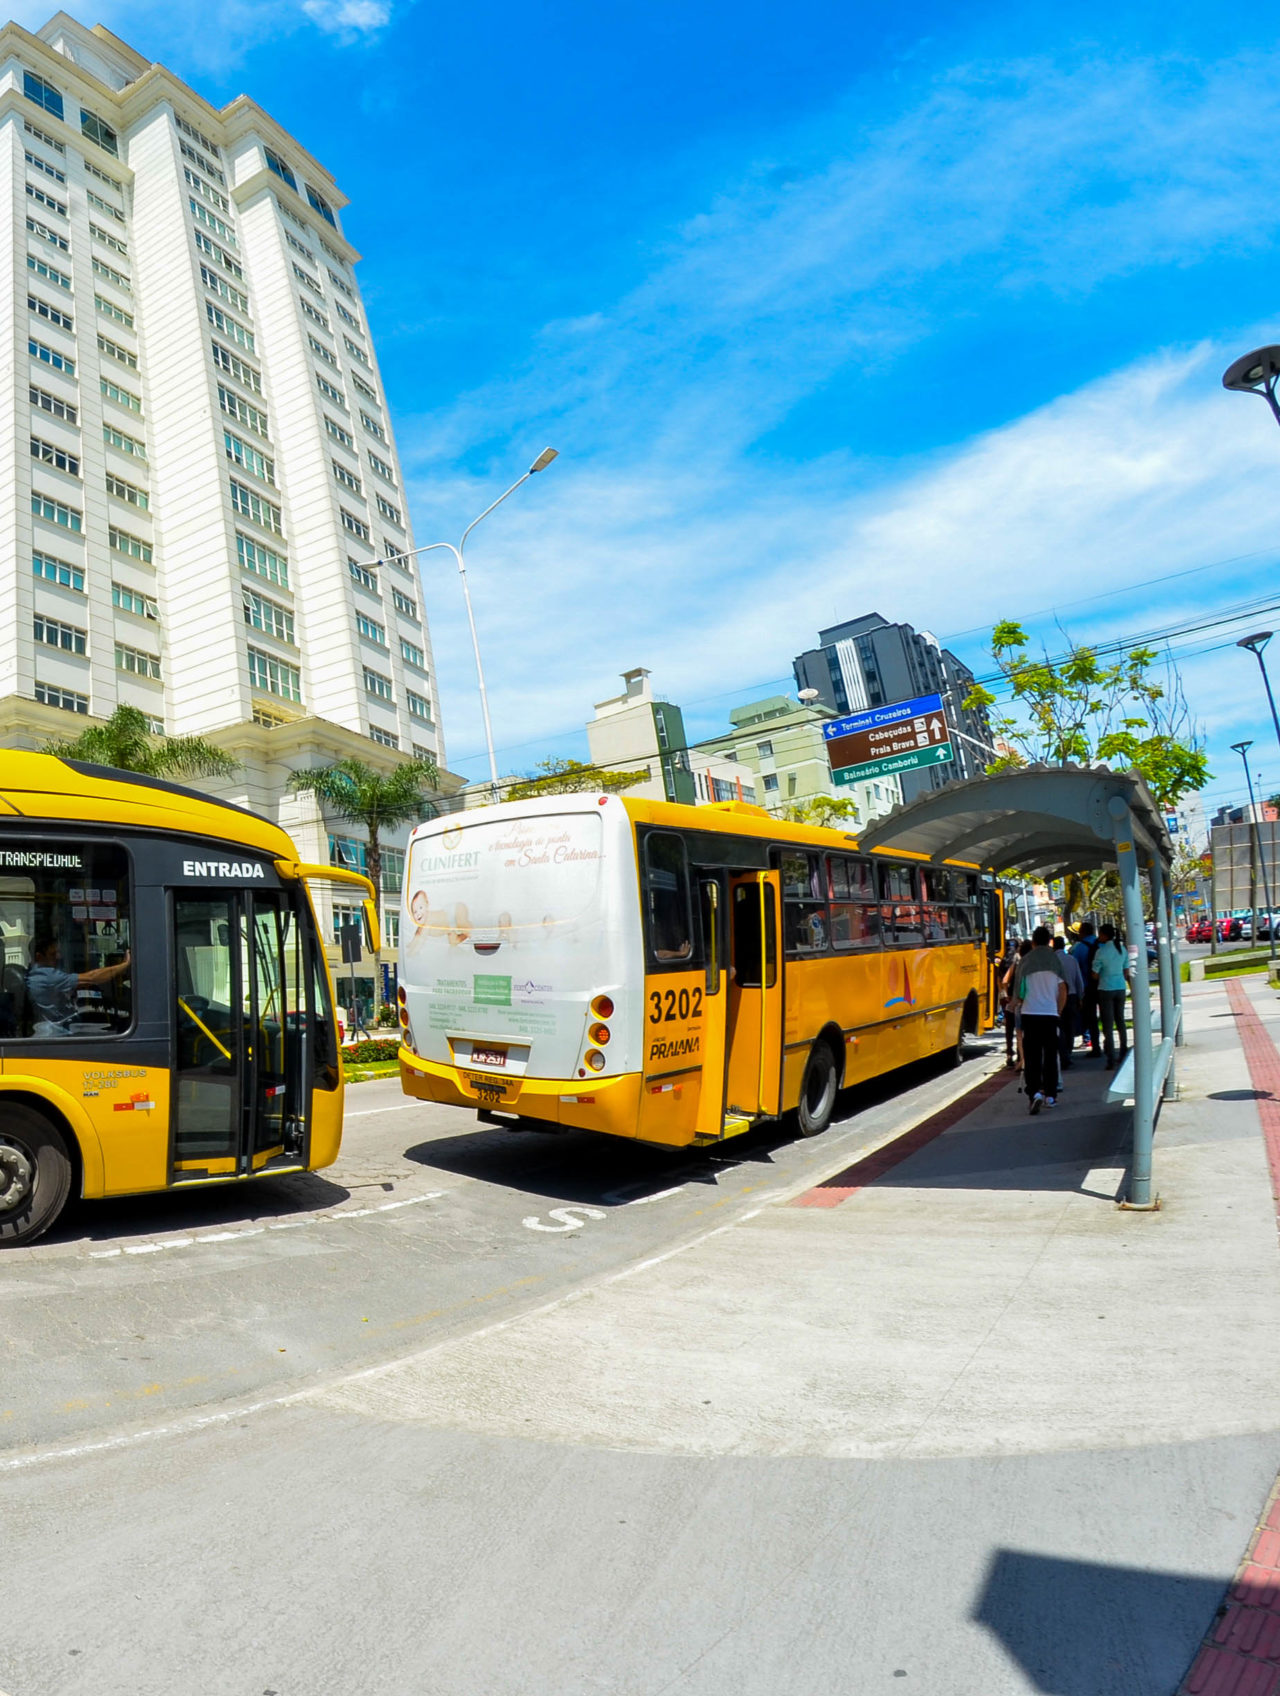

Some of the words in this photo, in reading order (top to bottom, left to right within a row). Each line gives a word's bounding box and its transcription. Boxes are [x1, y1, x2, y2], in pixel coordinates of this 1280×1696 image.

[841, 718, 873, 731] Terminal
[875, 706, 912, 722] Cruzeiros
[868, 724, 912, 742] Cabeçudas
[870, 746, 891, 756] Praia
[892, 739, 915, 751] Brava
[843, 766, 880, 780] Balneário
[881, 755, 919, 771] Camboriú
[421, 851, 480, 872] CLINIFERT
[518, 848, 550, 867] Santa
[183, 860, 265, 878] ENTRADA
[649, 987, 702, 1024] 3202
[650, 1036, 700, 1061] PRAIANA
[83, 1069, 147, 1079] VOLKSBUS
[477, 1088, 501, 1103] 3202
